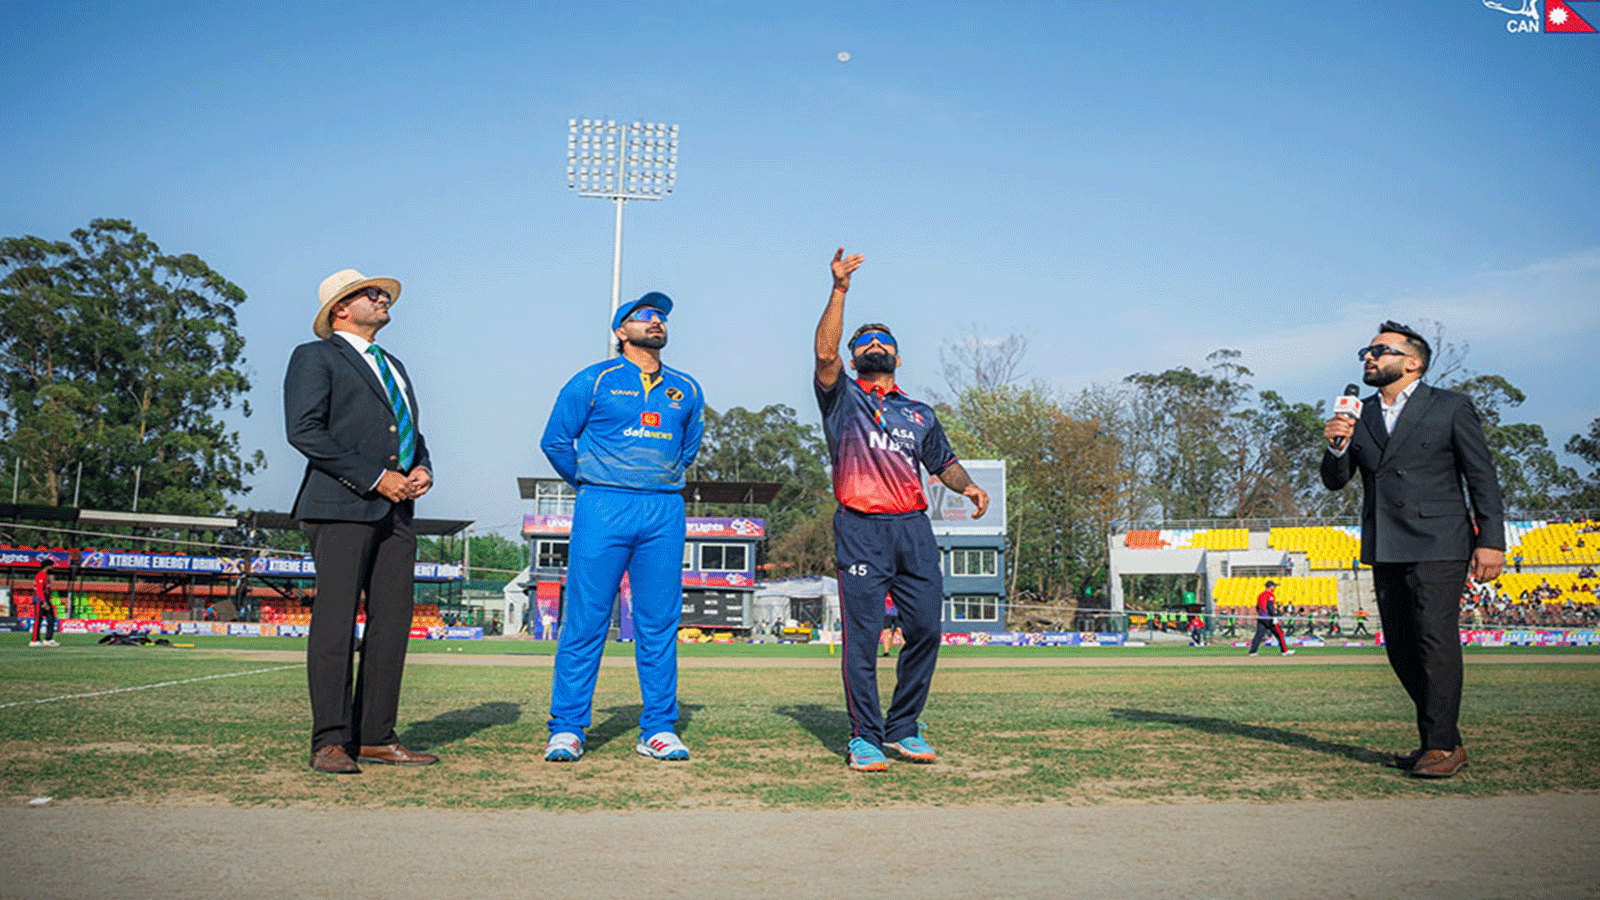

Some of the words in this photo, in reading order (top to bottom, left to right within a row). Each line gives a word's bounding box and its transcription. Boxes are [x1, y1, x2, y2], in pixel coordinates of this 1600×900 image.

[109, 554, 150, 567] XTREME
[152, 556, 191, 569] ENERGY
[268, 560, 301, 573] XTREME
[848, 564, 868, 576] 45
